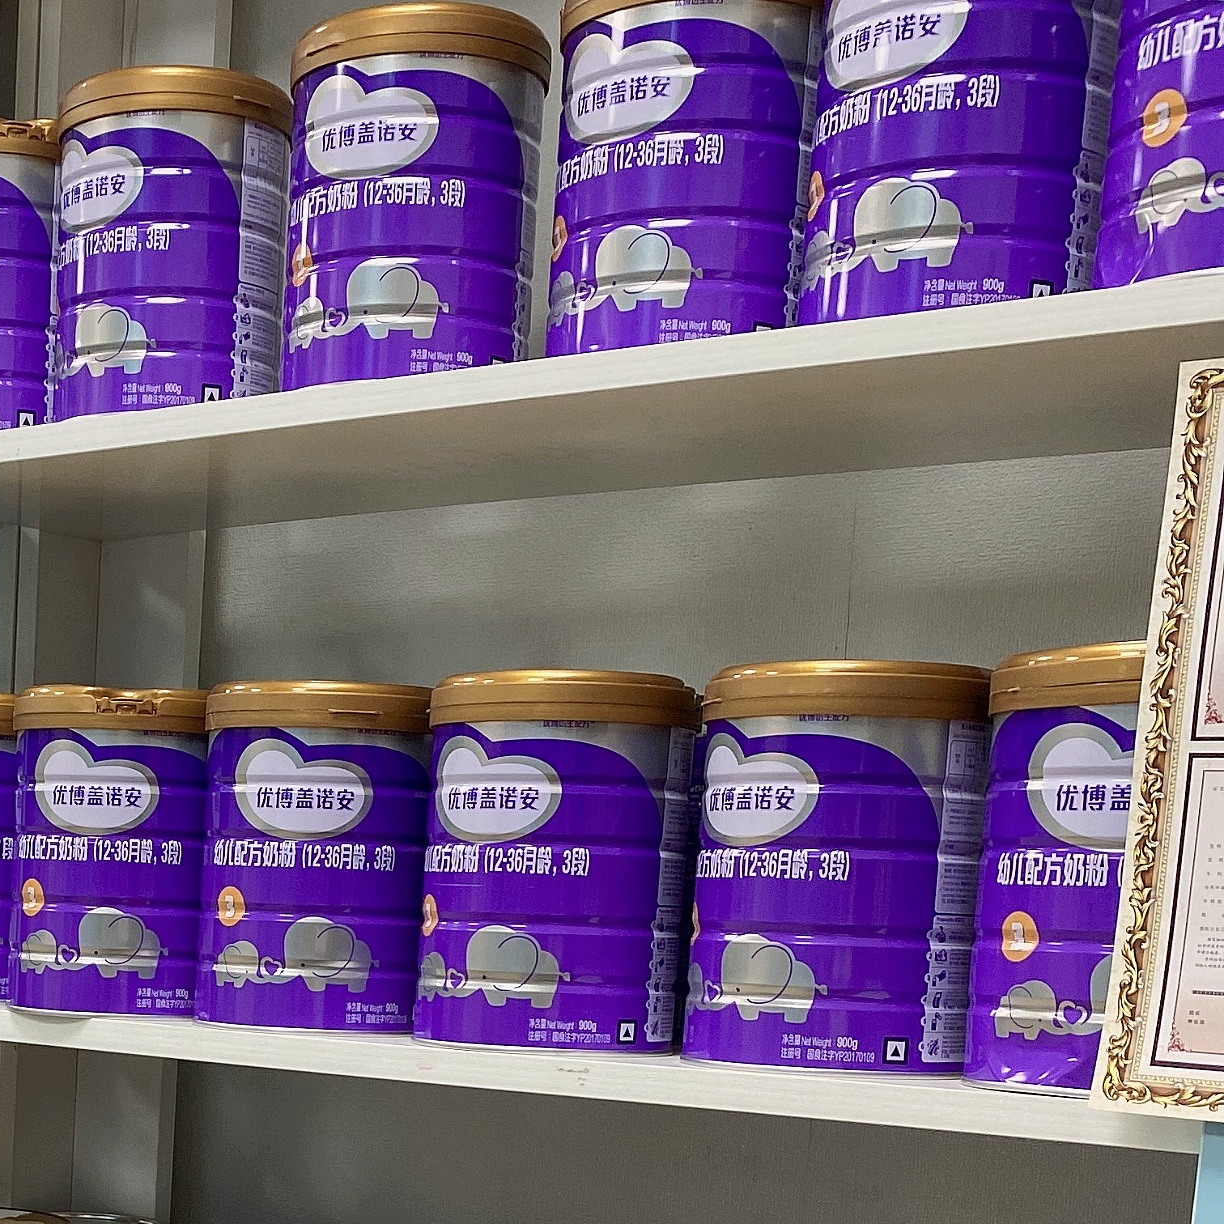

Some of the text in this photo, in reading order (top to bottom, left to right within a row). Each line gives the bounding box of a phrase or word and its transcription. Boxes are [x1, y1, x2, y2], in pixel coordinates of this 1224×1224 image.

[1137, 13, 1224, 71] 幼儿配方
[577, 73, 671, 118] 优博盖诺安
[321, 121, 418, 153] 优博盖诺安
[982, 279, 1005, 294] 900g
[52, 785, 142, 808] 优博盖诺安
[256, 787, 355, 811] 优博盖诺安
[448, 786, 540, 811] 优博盖诺安
[709, 785, 796, 812] 优博盖诺安
[213, 839, 296, 868] 幼儿配方奶粉
[996, 852, 1107, 887] 幼儿配方奶粉
[578, 1019, 597, 1033] 900g
[836, 1035, 858, 1050] 900g
